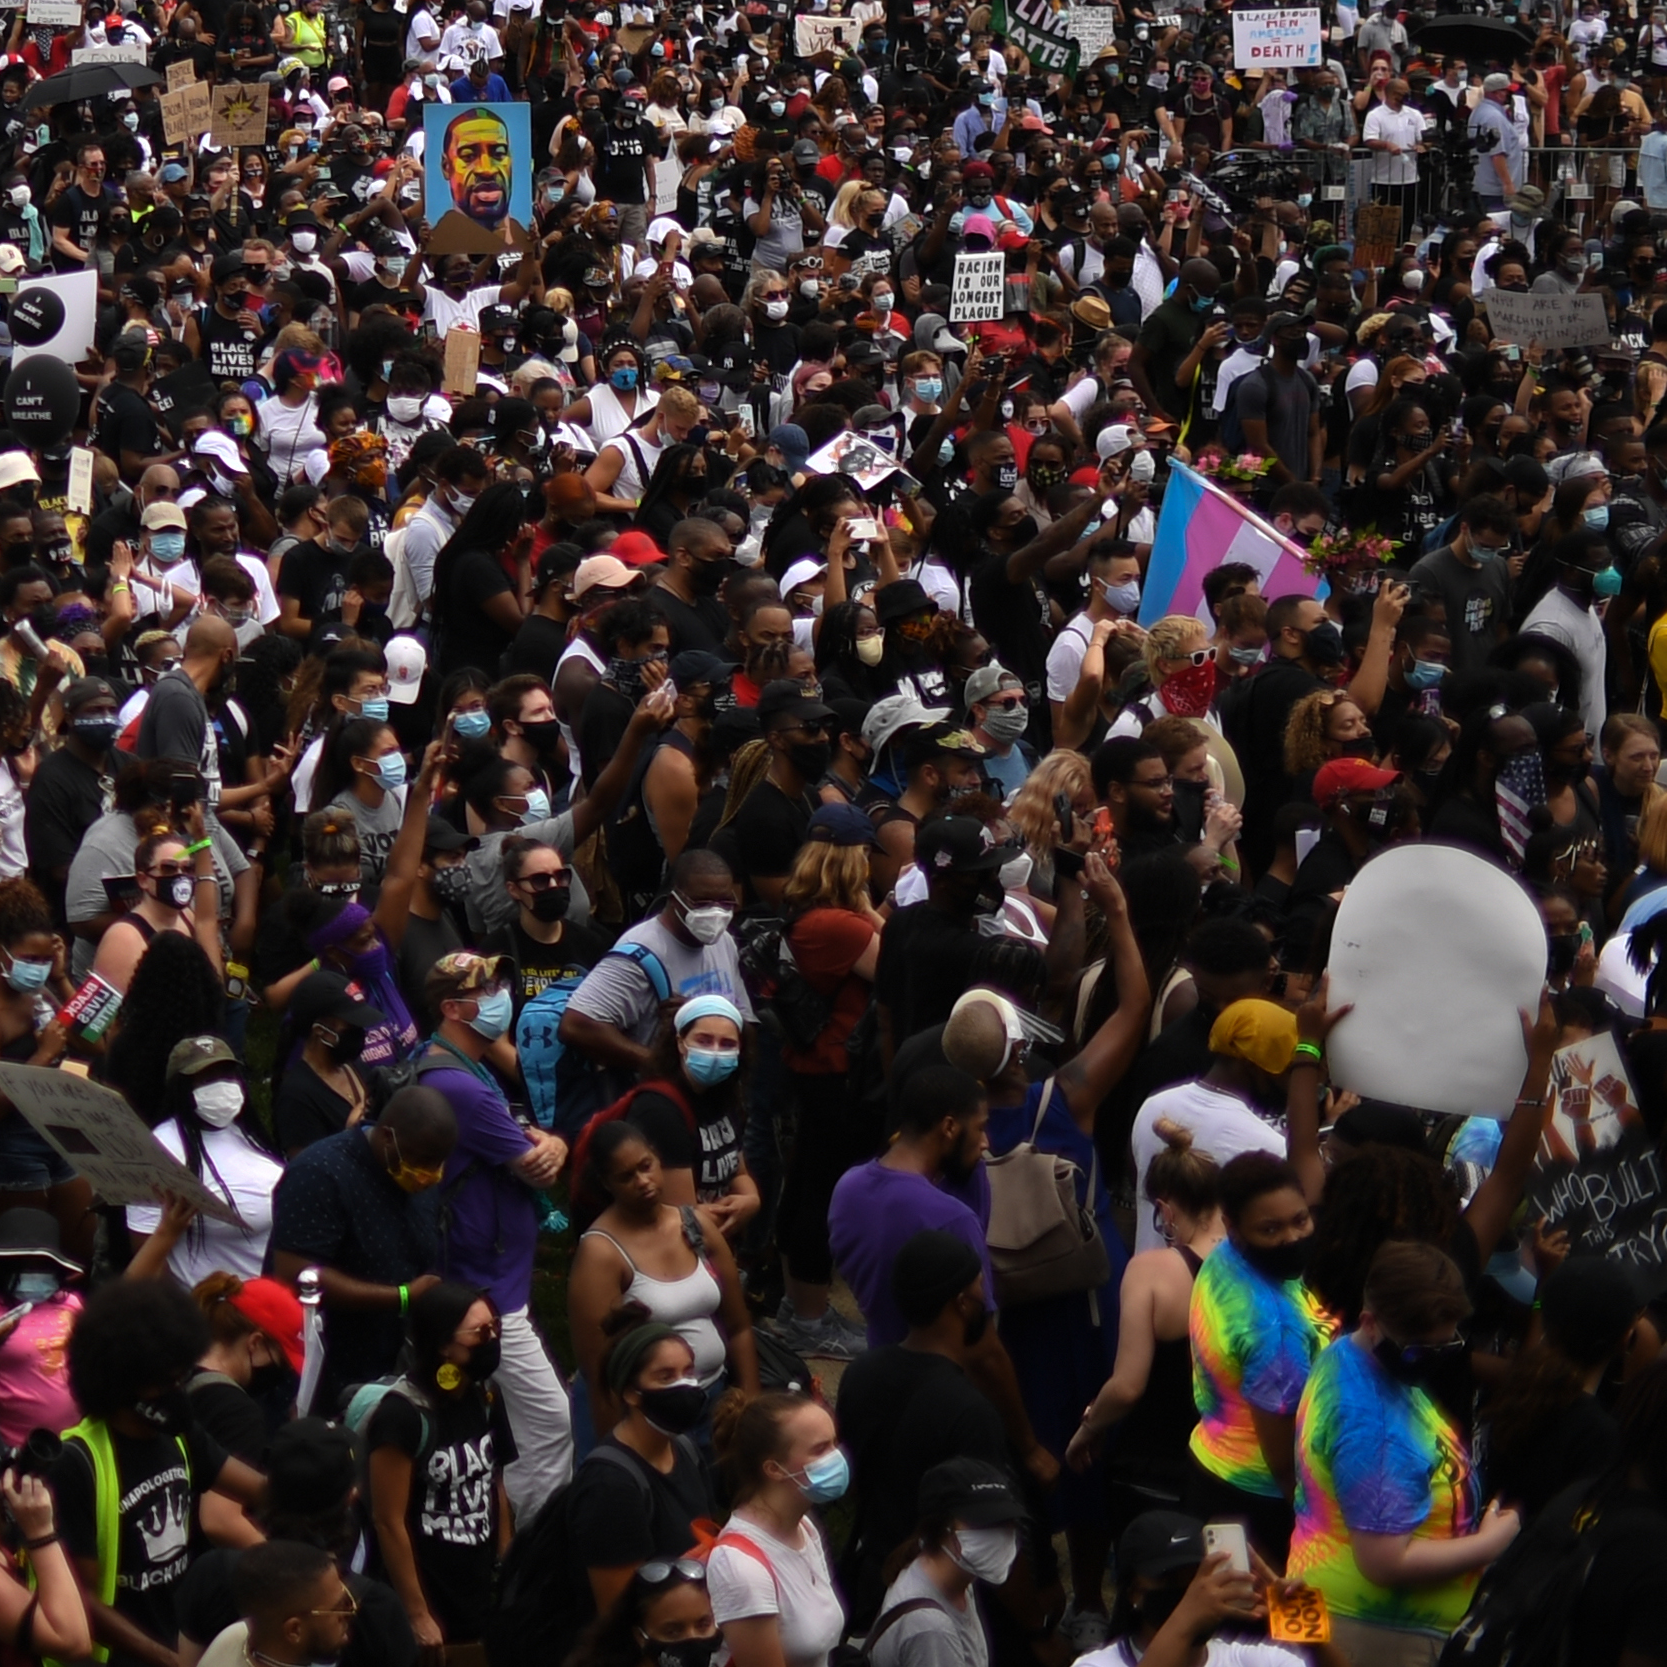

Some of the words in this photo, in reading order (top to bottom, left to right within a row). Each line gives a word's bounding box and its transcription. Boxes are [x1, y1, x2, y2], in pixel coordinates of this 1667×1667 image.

[1266, 18, 1299, 28] MEN
[957, 260, 1002, 274] RACISM
[957, 277, 971, 289] IS
[979, 275, 1001, 287] OUR
[952, 291, 1003, 304] LONGEST
[954, 306, 1000, 320] PLAGUE
[212, 353, 255, 366] LIVES
[11, 411, 53, 421] BREATHE
[1532, 1172, 1587, 1224] WHO
[1583, 1150, 1662, 1223] BUILT
[1582, 1222, 1615, 1247] THIS
[428, 1432, 495, 1484] BLAC
[1303, 1588, 1322, 1640] NOW
